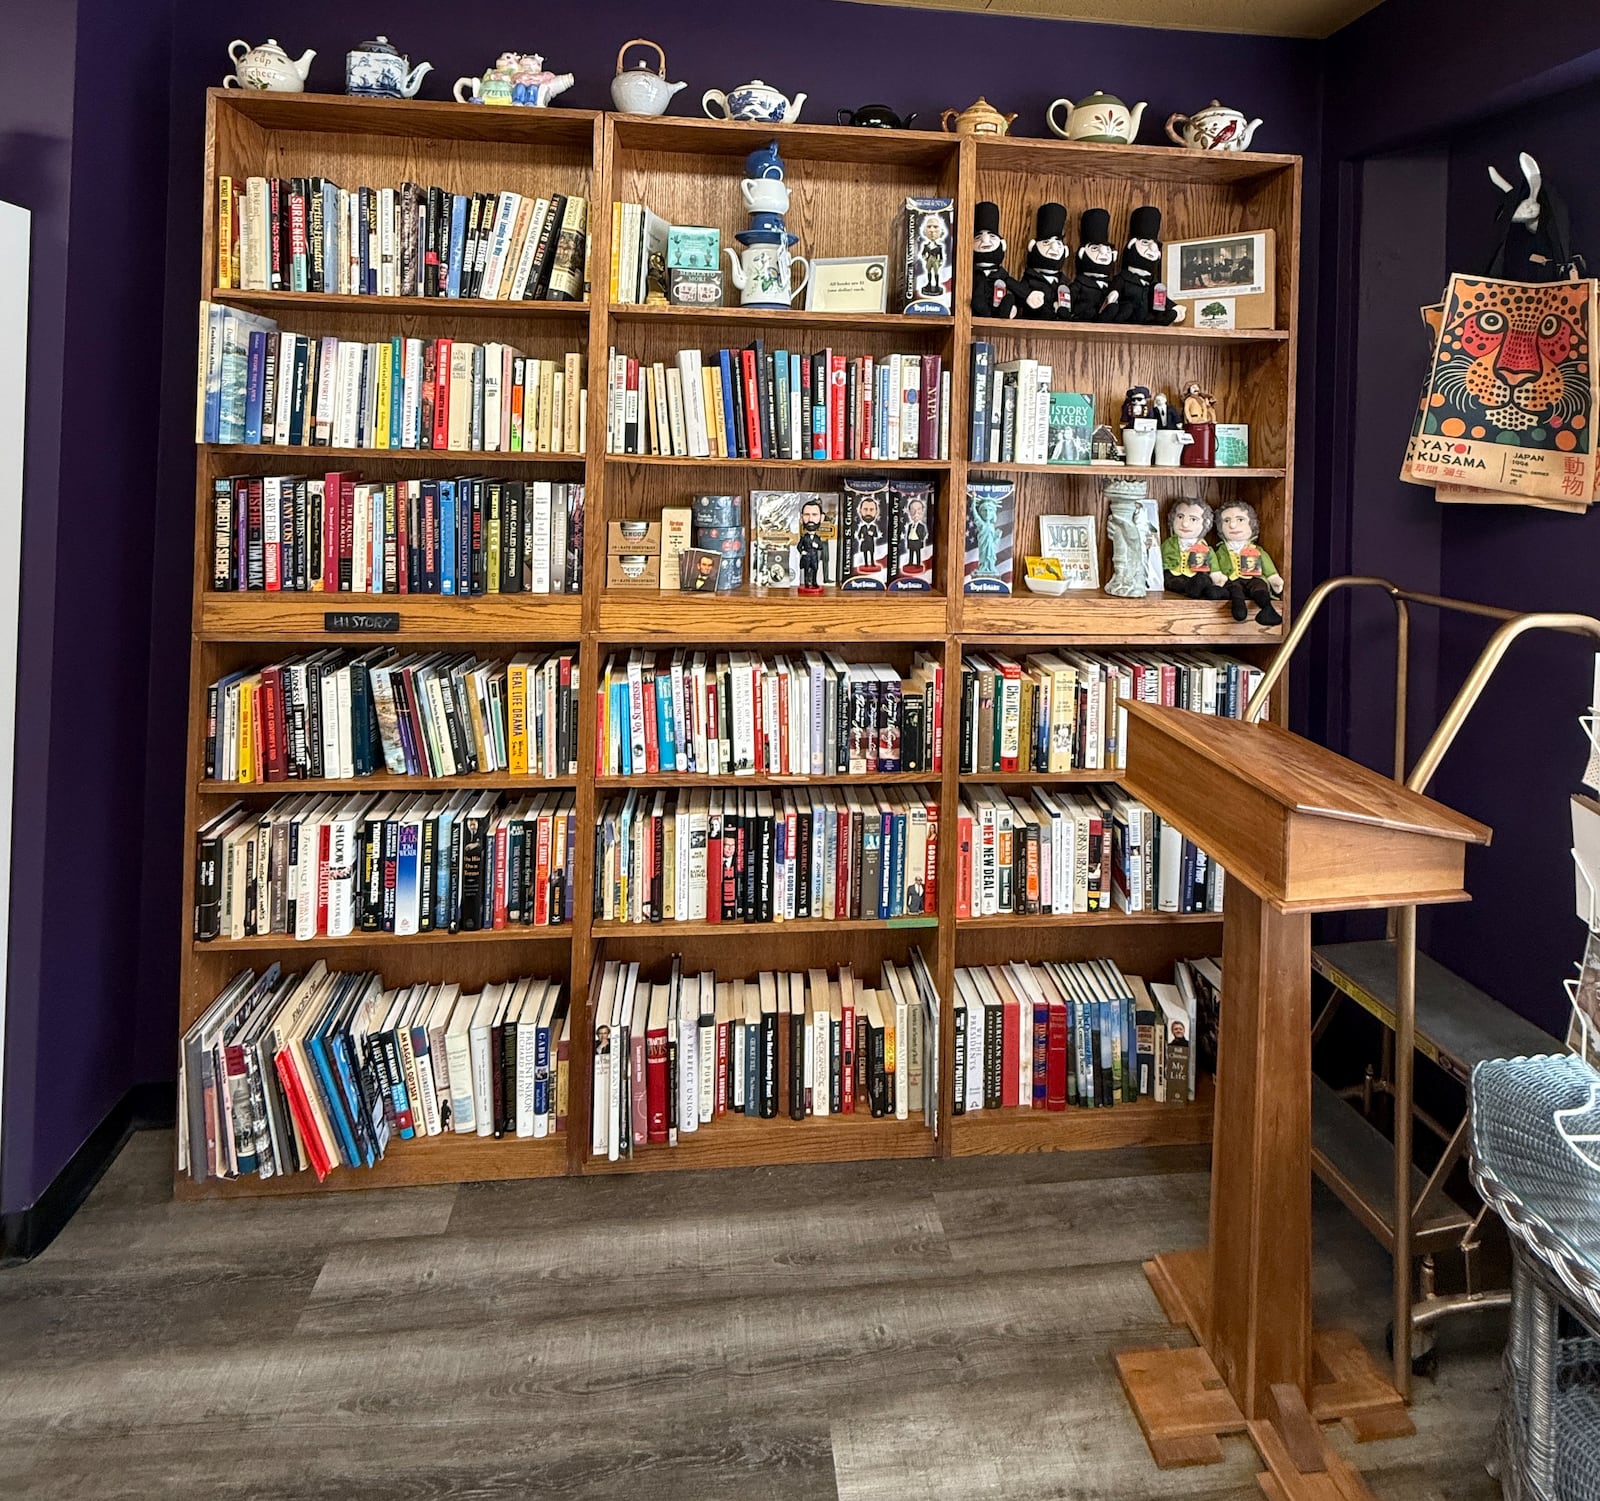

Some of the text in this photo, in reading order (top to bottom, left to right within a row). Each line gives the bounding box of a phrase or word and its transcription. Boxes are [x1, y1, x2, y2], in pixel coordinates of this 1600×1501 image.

[254, 56, 271, 66] cup
[291, 197, 304, 253] SURRENDER
[312, 190, 324, 272] Martin's Hundred
[906, 214, 915, 299] GEORGE WASHINGTON
[320, 341, 331, 402] AMERICAN SPIRIT
[405, 386, 413, 438] EXCEPTIONAL
[926, 386, 937, 421] NAPA
[1050, 406, 1089, 416] ISTORY
[1005, 411, 1013, 449] KENNEDY
[1421, 439, 1472, 455] YAYOI
[1417, 452, 1487, 469] KUSAMA
[1512, 452, 1545, 462] JAPAN
[1561, 456, 1585, 497] 動物
[265, 487, 276, 542] LARRY ELDER
[283, 488, 293, 545] AT ANY COST
[508, 505, 517, 521] MAN
[216, 498, 230, 579] CRUELTY AND SILENCE
[249, 484, 262, 588] MISFIRE TIM MAK
[425, 498, 434, 569] ABRAHAM LINCOLN'S
[508, 521, 517, 547] CALLED
[1048, 526, 1088, 548] VOTE
[266, 544, 277, 583] SHOWDOWN
[385, 542, 396, 583] BILL O'REILLY
[508, 548, 516, 577] INTREPID
[844, 538, 852, 575] ULYSSES
[333, 615, 393, 628] HISTORY
[284, 692, 293, 715] KERRY
[291, 669, 300, 702] BADNESS
[512, 671, 523, 738] REAL LIFE DRAMA
[744, 709, 750, 718] OF
[655, 819, 662, 831] ON
[451, 845, 459, 863] Haley
[761, 859, 769, 884] Anthony
[928, 844, 936, 881] GODLESS
[983, 824, 995, 891] NEW NEW DEAL
[1027, 840, 1037, 877] COLLAPSE
[319, 860, 330, 907] PROTOCOL
[334, 825, 345, 929] SHADOW BOB WOODWARD
[384, 861, 396, 888] 2010
[512, 845, 521, 904] THE COURTS OF LOVE
[747, 851, 755, 903] THE BLUEPRINT
[761, 884, 769, 901] Fauci
[538, 1032, 547, 1065] GABBY
[704, 1030, 712, 1062] HIDDEN
[977, 1027, 982, 1038] WE
[1037, 1023, 1046, 1078] TOM BROKAW
[373, 1045, 384, 1063] JUST
[386, 1042, 401, 1083] SEAN HANNITY
[401, 1032, 418, 1101] AN EAGLE'S ODYSSEY
[524, 1030, 534, 1113] PRESIDENT NIXON
[859, 1056, 867, 1084] EICHMANN
[1172, 1062, 1184, 1070] My
[376, 1063, 391, 1097] RESPONSE
[420, 1067, 436, 1124] MISUNDERESTIMATED
[765, 1080, 773, 1097] Fauci
[955, 1066, 963, 1102] POLITICIAN
